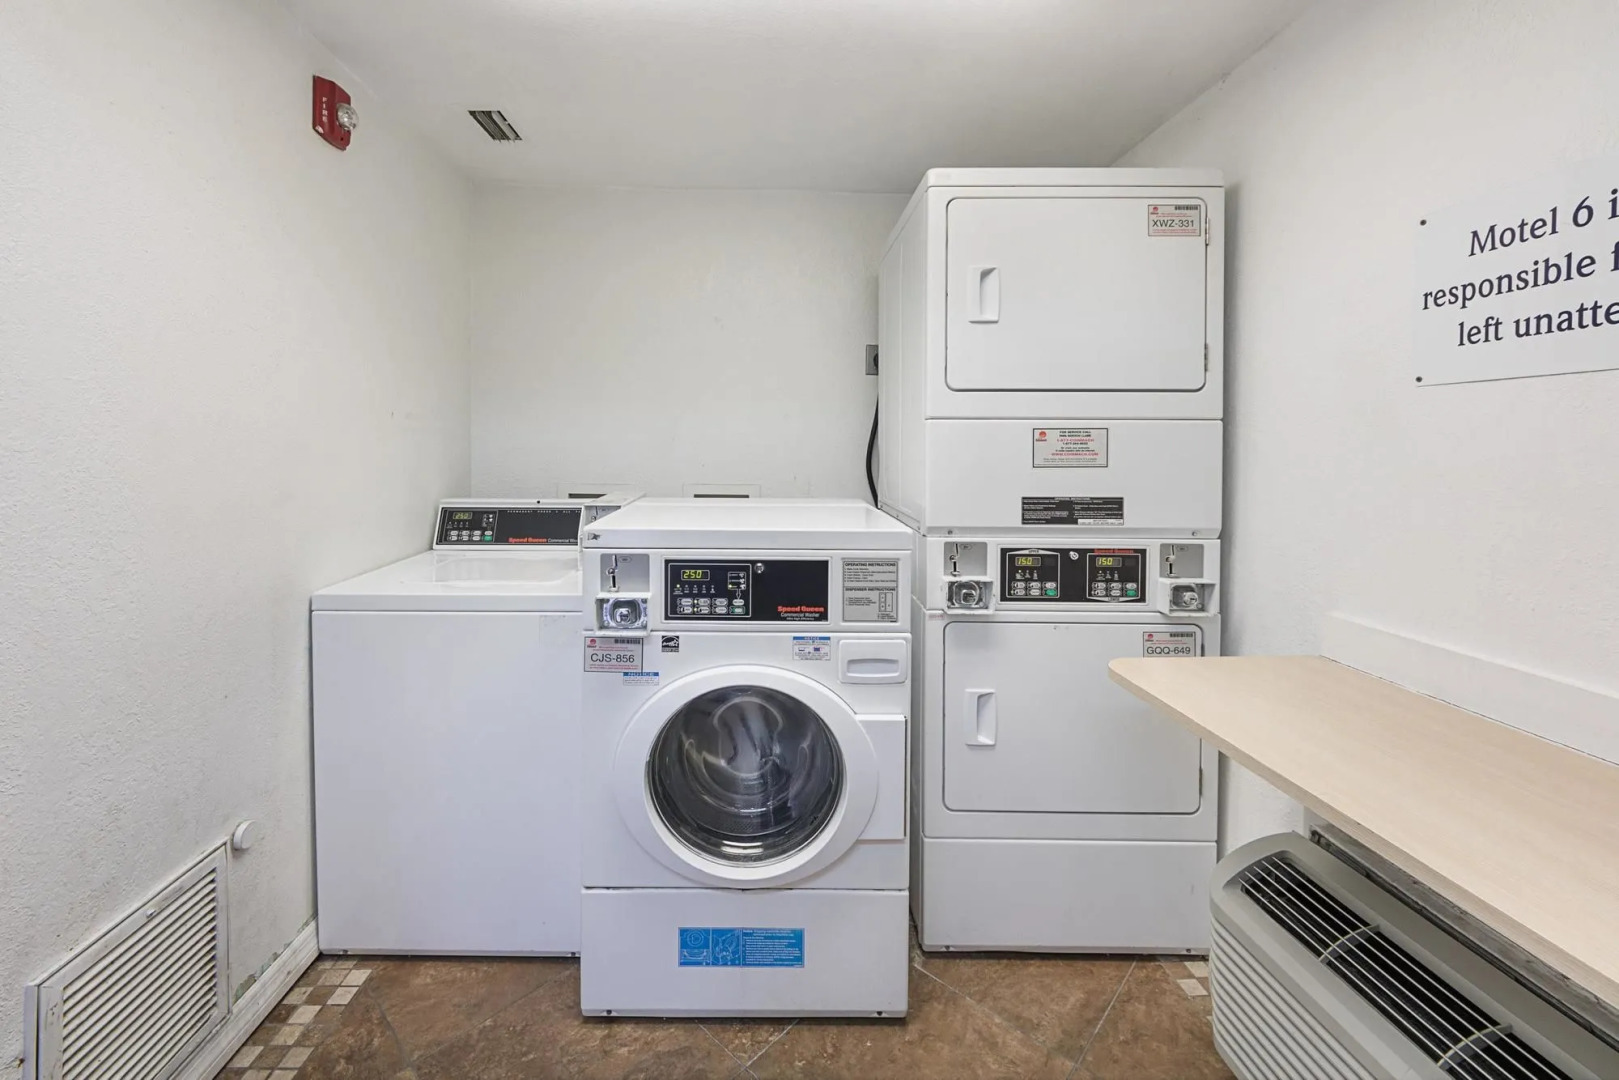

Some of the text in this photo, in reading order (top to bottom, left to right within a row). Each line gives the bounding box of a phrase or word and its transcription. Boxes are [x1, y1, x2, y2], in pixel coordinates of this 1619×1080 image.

[1152, 219, 1194, 228] XWZ-331
[1468, 206, 1560, 257] Motel
[1572, 195, 1595, 228] 6
[1421, 251, 1597, 311] responsible
[1457, 315, 1504, 347] left
[1018, 557, 1033, 565] 150
[1098, 557, 1113, 566] 150
[683, 569, 702, 579] 250
[777, 605, 800, 613] Speed
[1146, 646, 1191, 655] GQQ-649
[590, 652, 635, 664] CJS-856
